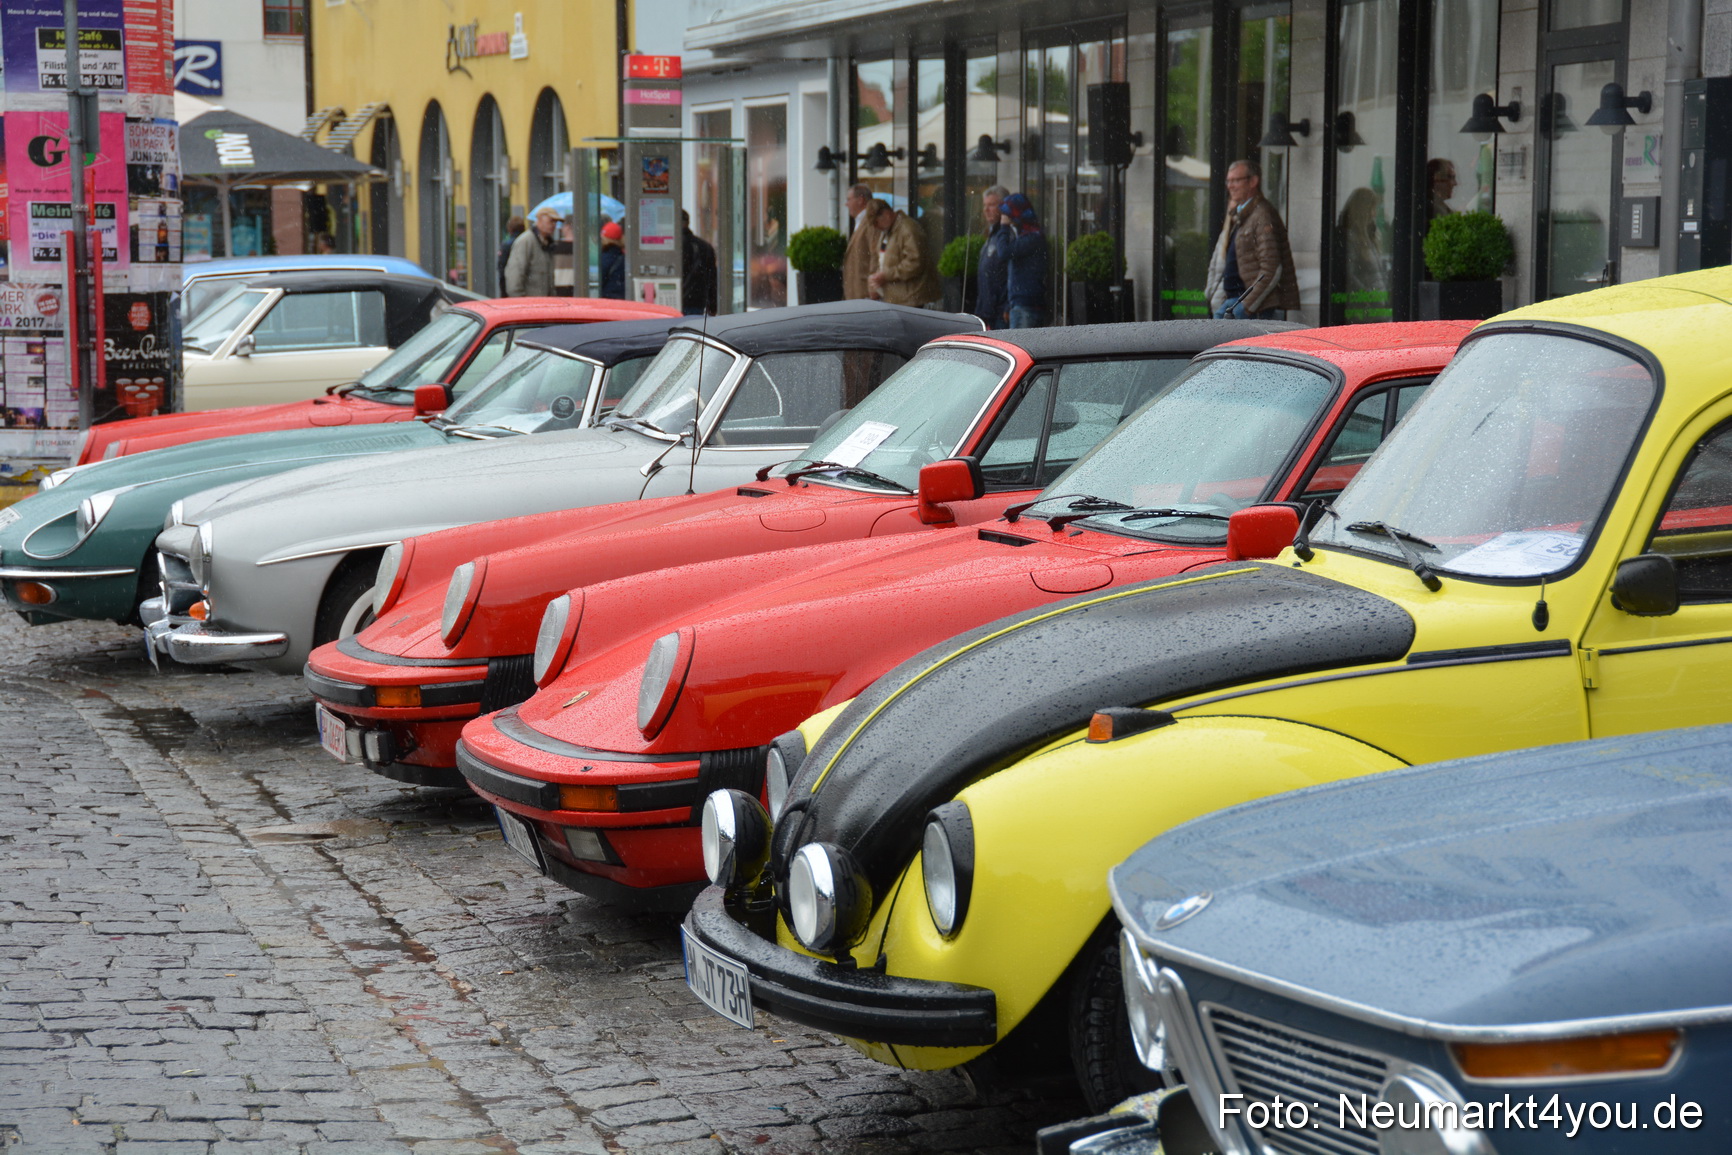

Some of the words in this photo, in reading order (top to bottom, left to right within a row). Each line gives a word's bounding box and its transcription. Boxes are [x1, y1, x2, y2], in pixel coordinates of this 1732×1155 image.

[82, 61, 98, 71] und
[653, 57, 670, 77] T
[42, 74, 55, 85] Fr.
[94, 75, 106, 86] 20
[108, 75, 123, 86] Uhr
[640, 89, 671, 100] HotSpot
[129, 124, 166, 138] SOMMER
[129, 138, 141, 149] IM
[143, 138, 165, 150] PARK
[130, 150, 152, 162] JUNI
[32, 204, 71, 218] Mein
[33, 248, 47, 258] Fr.
[48, 248, 59, 257] 2.
[15, 316, 45, 328] 2017
